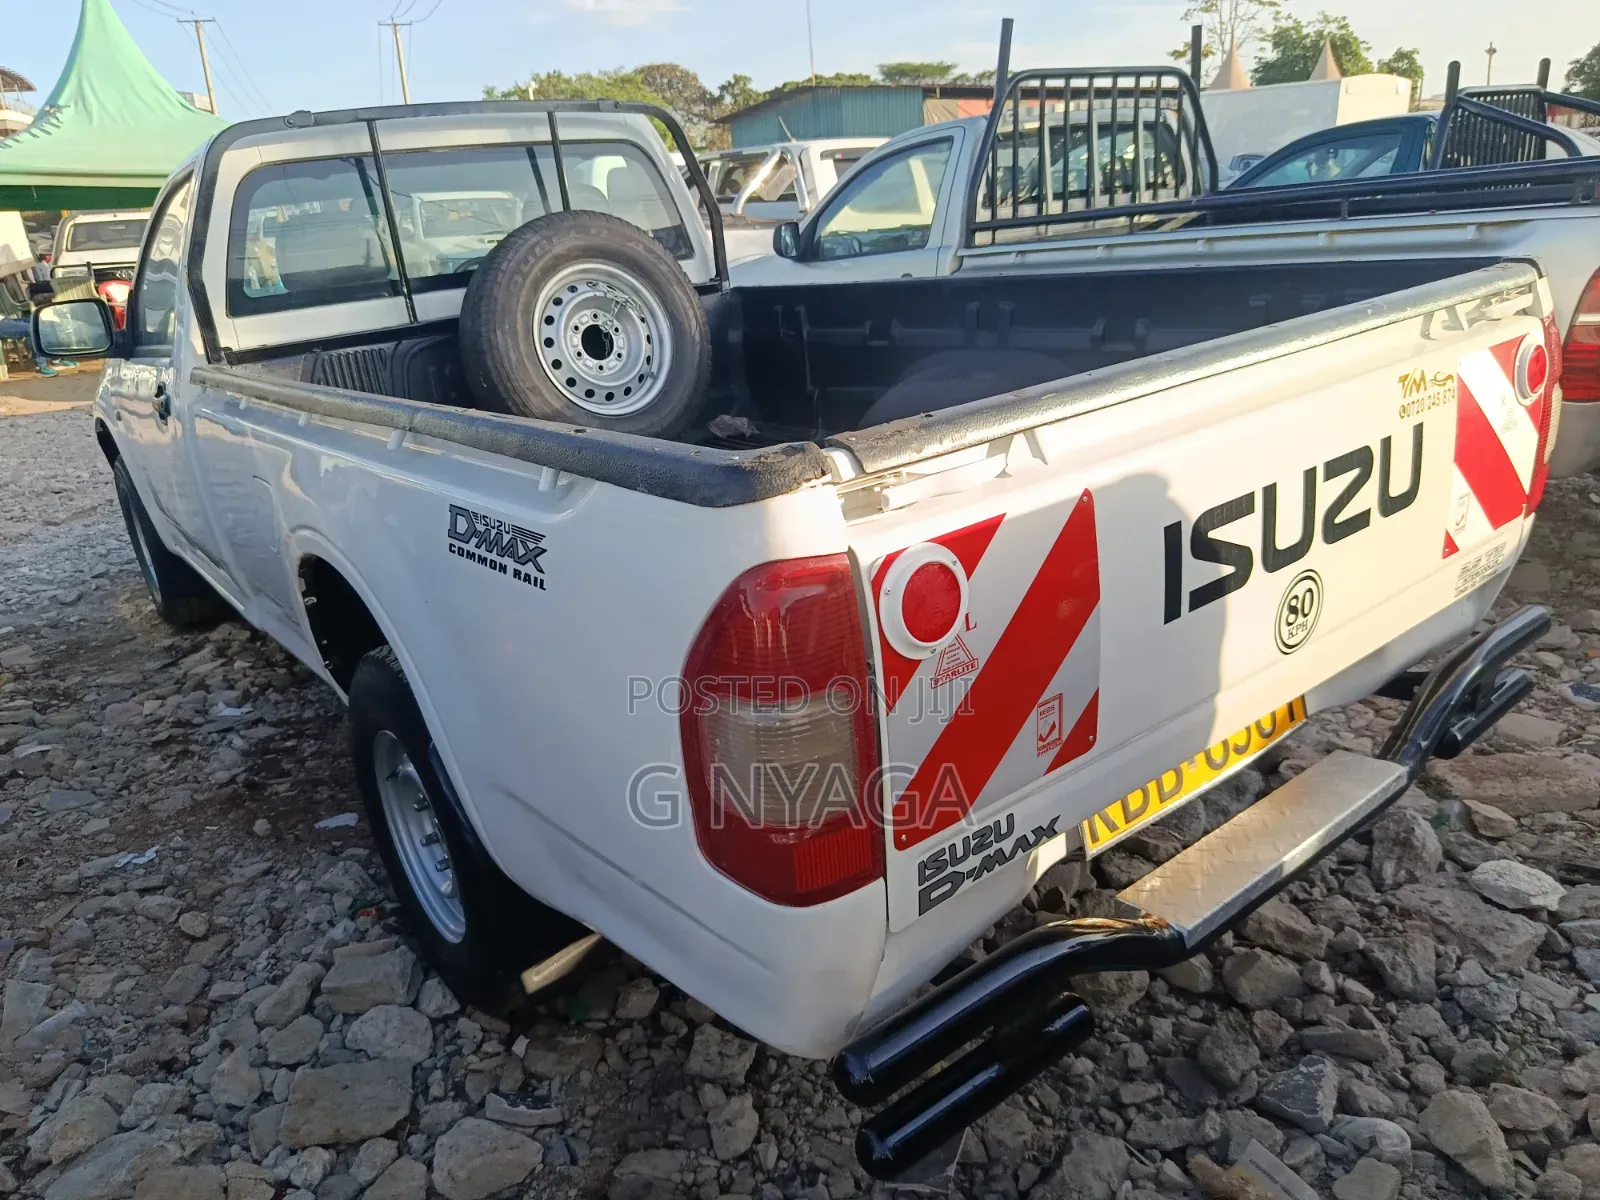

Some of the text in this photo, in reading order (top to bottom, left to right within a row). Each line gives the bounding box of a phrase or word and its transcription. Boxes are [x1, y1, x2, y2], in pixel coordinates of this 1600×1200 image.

[1407, 398, 1424, 417] 0720
[1428, 391, 1441, 411] 245
[479, 513, 511, 535] ISUZU
[1163, 421, 1424, 625] ISUZU
[448, 503, 547, 575] D-MAX
[448, 542, 508, 575] COMMON
[513, 567, 547, 591] RAIL
[1285, 587, 1314, 626] 80
[964, 611, 977, 632] L
[1286, 619, 1308, 640] KPH
[933, 661, 977, 687] STARLITE
[917, 812, 1015, 887] ISUZU
[918, 814, 1062, 917] D-MAX
